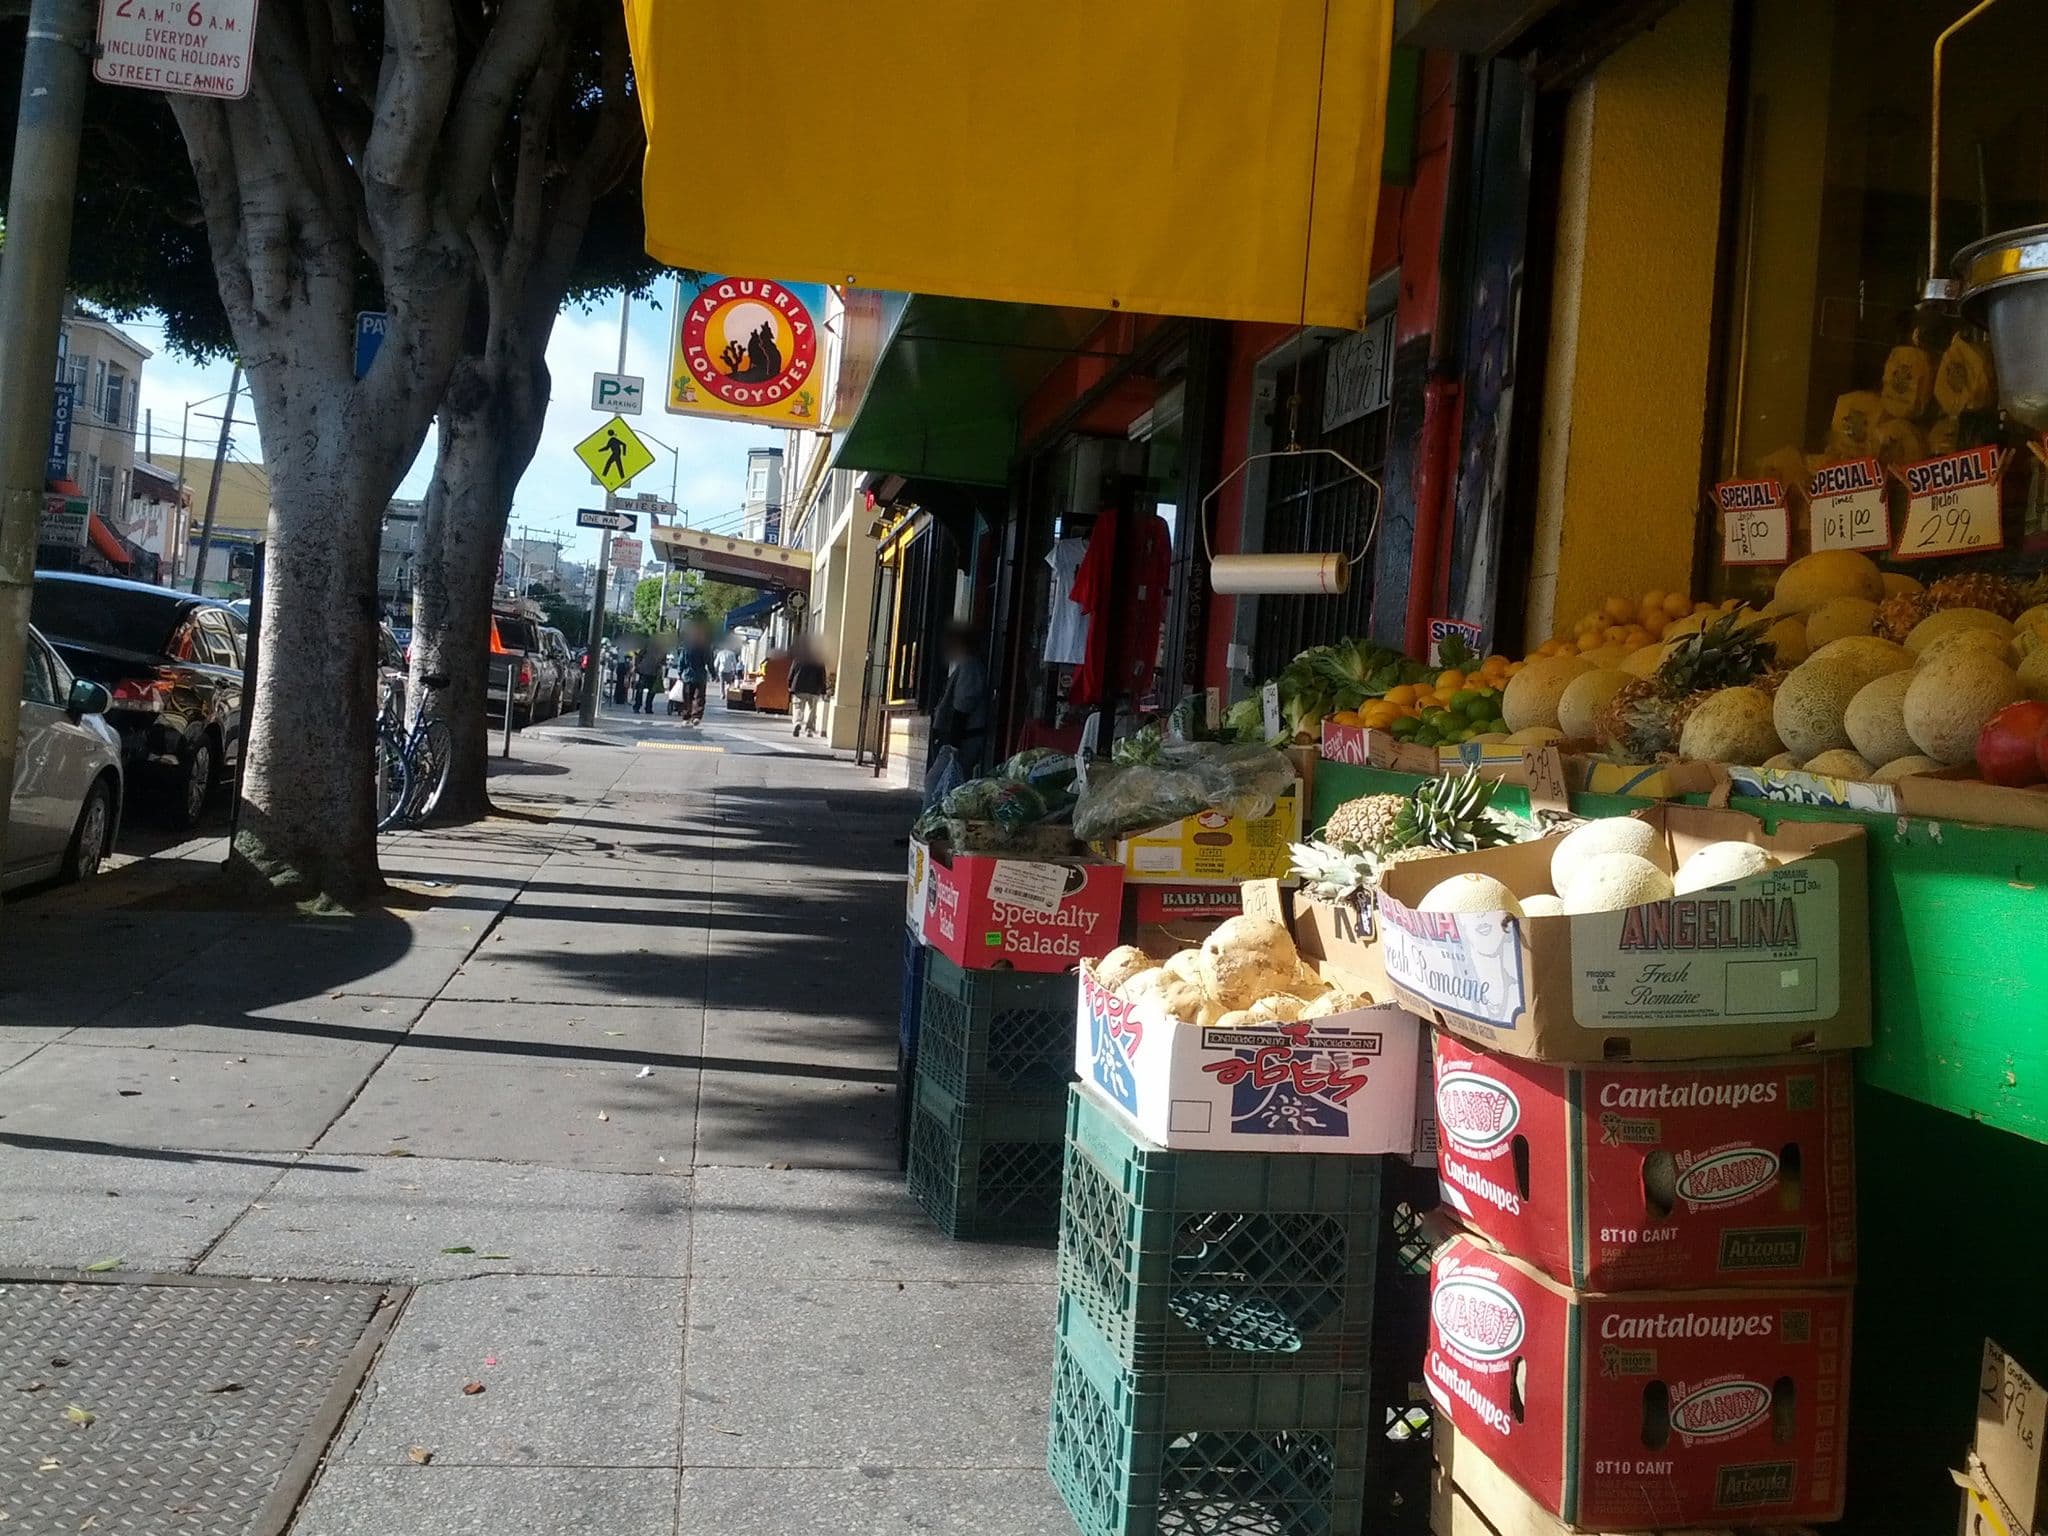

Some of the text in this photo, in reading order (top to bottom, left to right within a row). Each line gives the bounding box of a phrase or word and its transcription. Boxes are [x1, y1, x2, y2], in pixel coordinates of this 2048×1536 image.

[116, 0, 131, 17] 2
[170, 2, 181, 13] TO
[187, 2, 202, 27] 6
[209, 16, 242, 32] A.M.
[145, 28, 208, 48] EVERYDAY
[108, 40, 241, 69] INCLUDING HOLIDAYS
[109, 63, 234, 91] STREET CLEANING
[691, 281, 808, 335] TAQUERIA
[689, 345, 807, 402] LOS COYOTES
[53, 394, 69, 457] HOTEL
[583, 514, 620, 526] ONE WAY
[625, 501, 669, 513] WIESE
[1163, 893, 1207, 905] BABY
[992, 902, 1100, 935] Specialty
[1619, 898, 1799, 953] ANGELINA
[1005, 930, 1080, 957] Salads
[1386, 934, 1411, 976] resh
[1411, 944, 1490, 1006] Romaine
[1636, 961, 1693, 983] Fresh
[1625, 985, 1701, 1006] Romaine
[1209, 1033, 1256, 1044] EXPERIENCE
[1312, 1038, 1362, 1048] EXCEPTIONAL
[1600, 1082, 1778, 1108] Cantaloupes
[1444, 1153, 1520, 1216] Cantaloupes
[1689, 1156, 1768, 1196] KANDY
[1642, 1227, 1680, 1243] CANT
[1729, 1236, 1797, 1257] Arizona
[1601, 1313, 1773, 1340] Cantaloupes
[1431, 1350, 1511, 1436] Cantaloupes
[1682, 1389, 1761, 1429] KANDY
[1636, 1461, 1674, 1475] CANT
[1725, 1468, 1787, 1496] Arizona
